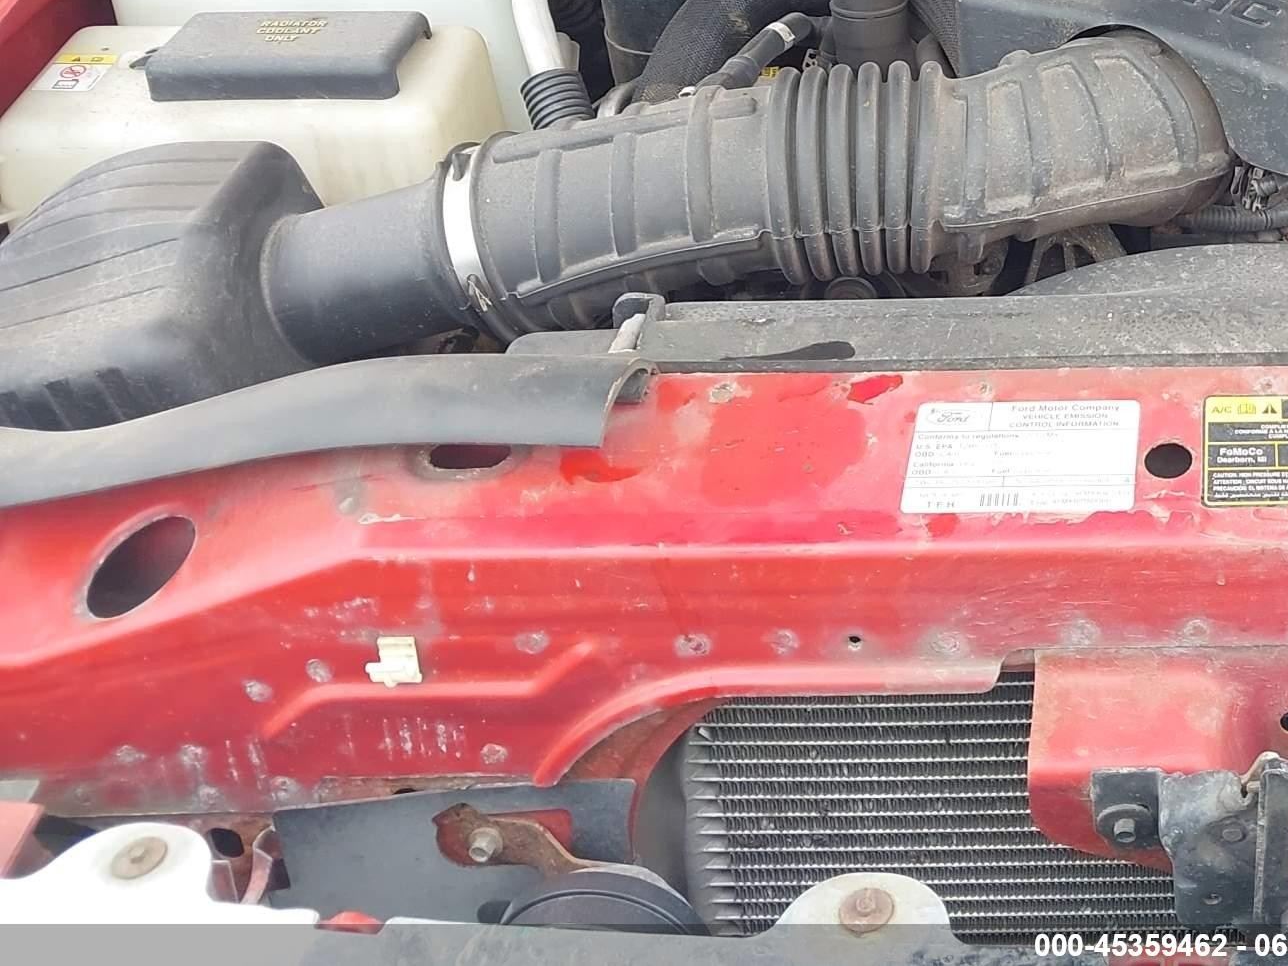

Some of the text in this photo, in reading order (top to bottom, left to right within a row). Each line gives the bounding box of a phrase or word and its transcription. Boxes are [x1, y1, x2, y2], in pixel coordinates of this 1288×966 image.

[264, 34, 298, 42] ONLY
[1011, 404, 1120, 412] Ford Motor Company
[937, 412, 970, 423] Ford
[1219, 448, 1263, 456] FoMoCo
